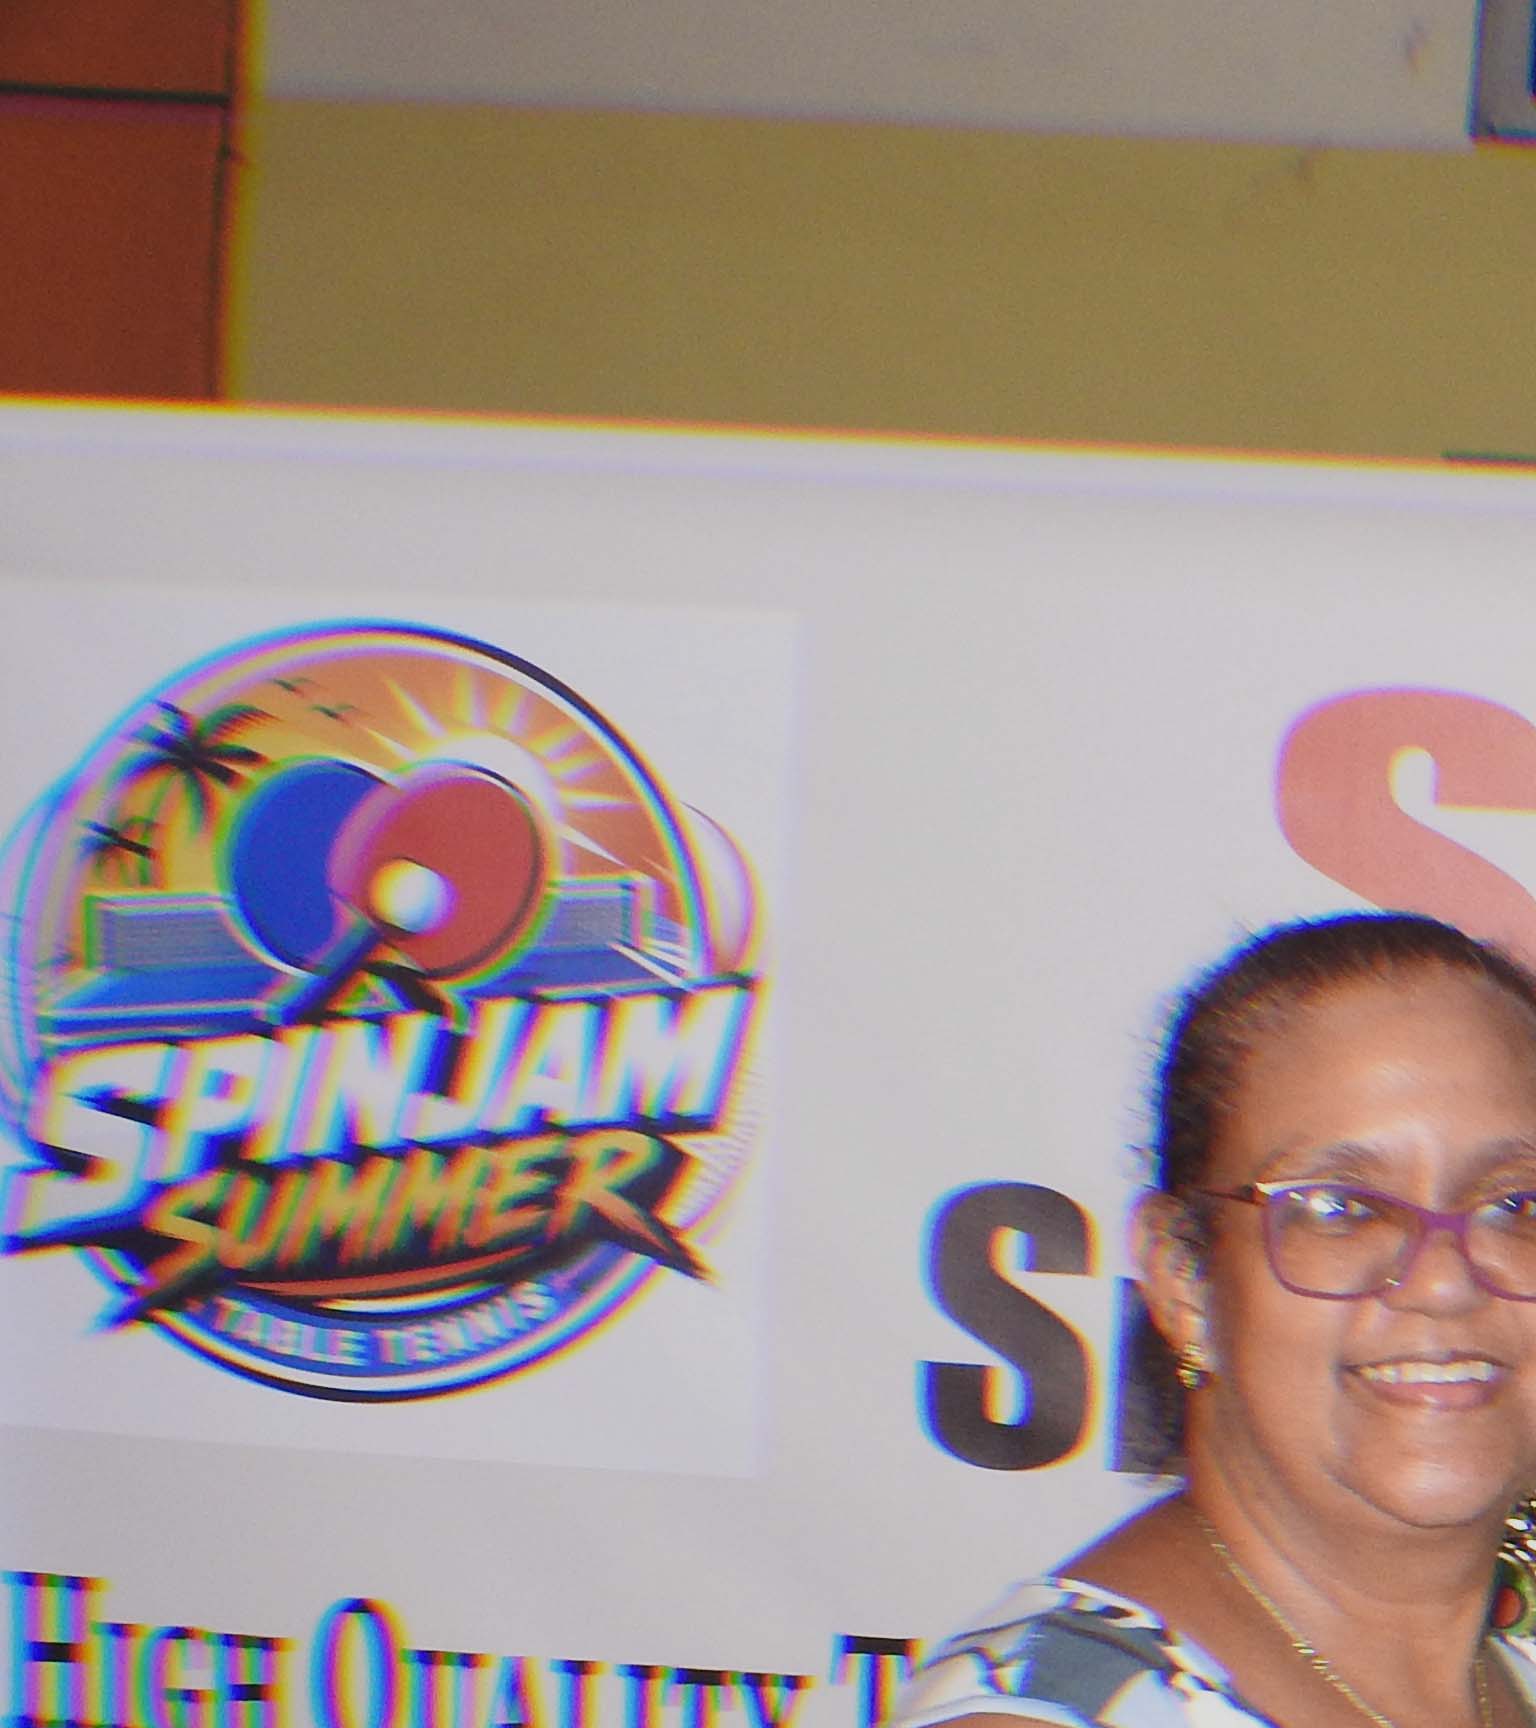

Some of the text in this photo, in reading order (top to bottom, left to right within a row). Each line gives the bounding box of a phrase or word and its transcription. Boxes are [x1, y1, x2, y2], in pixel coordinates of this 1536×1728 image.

[0, 982, 758, 1245] SPINJAM
[118, 1128, 712, 1310] SUMMER
[212, 1280, 558, 1366] TABLE TENNIS
